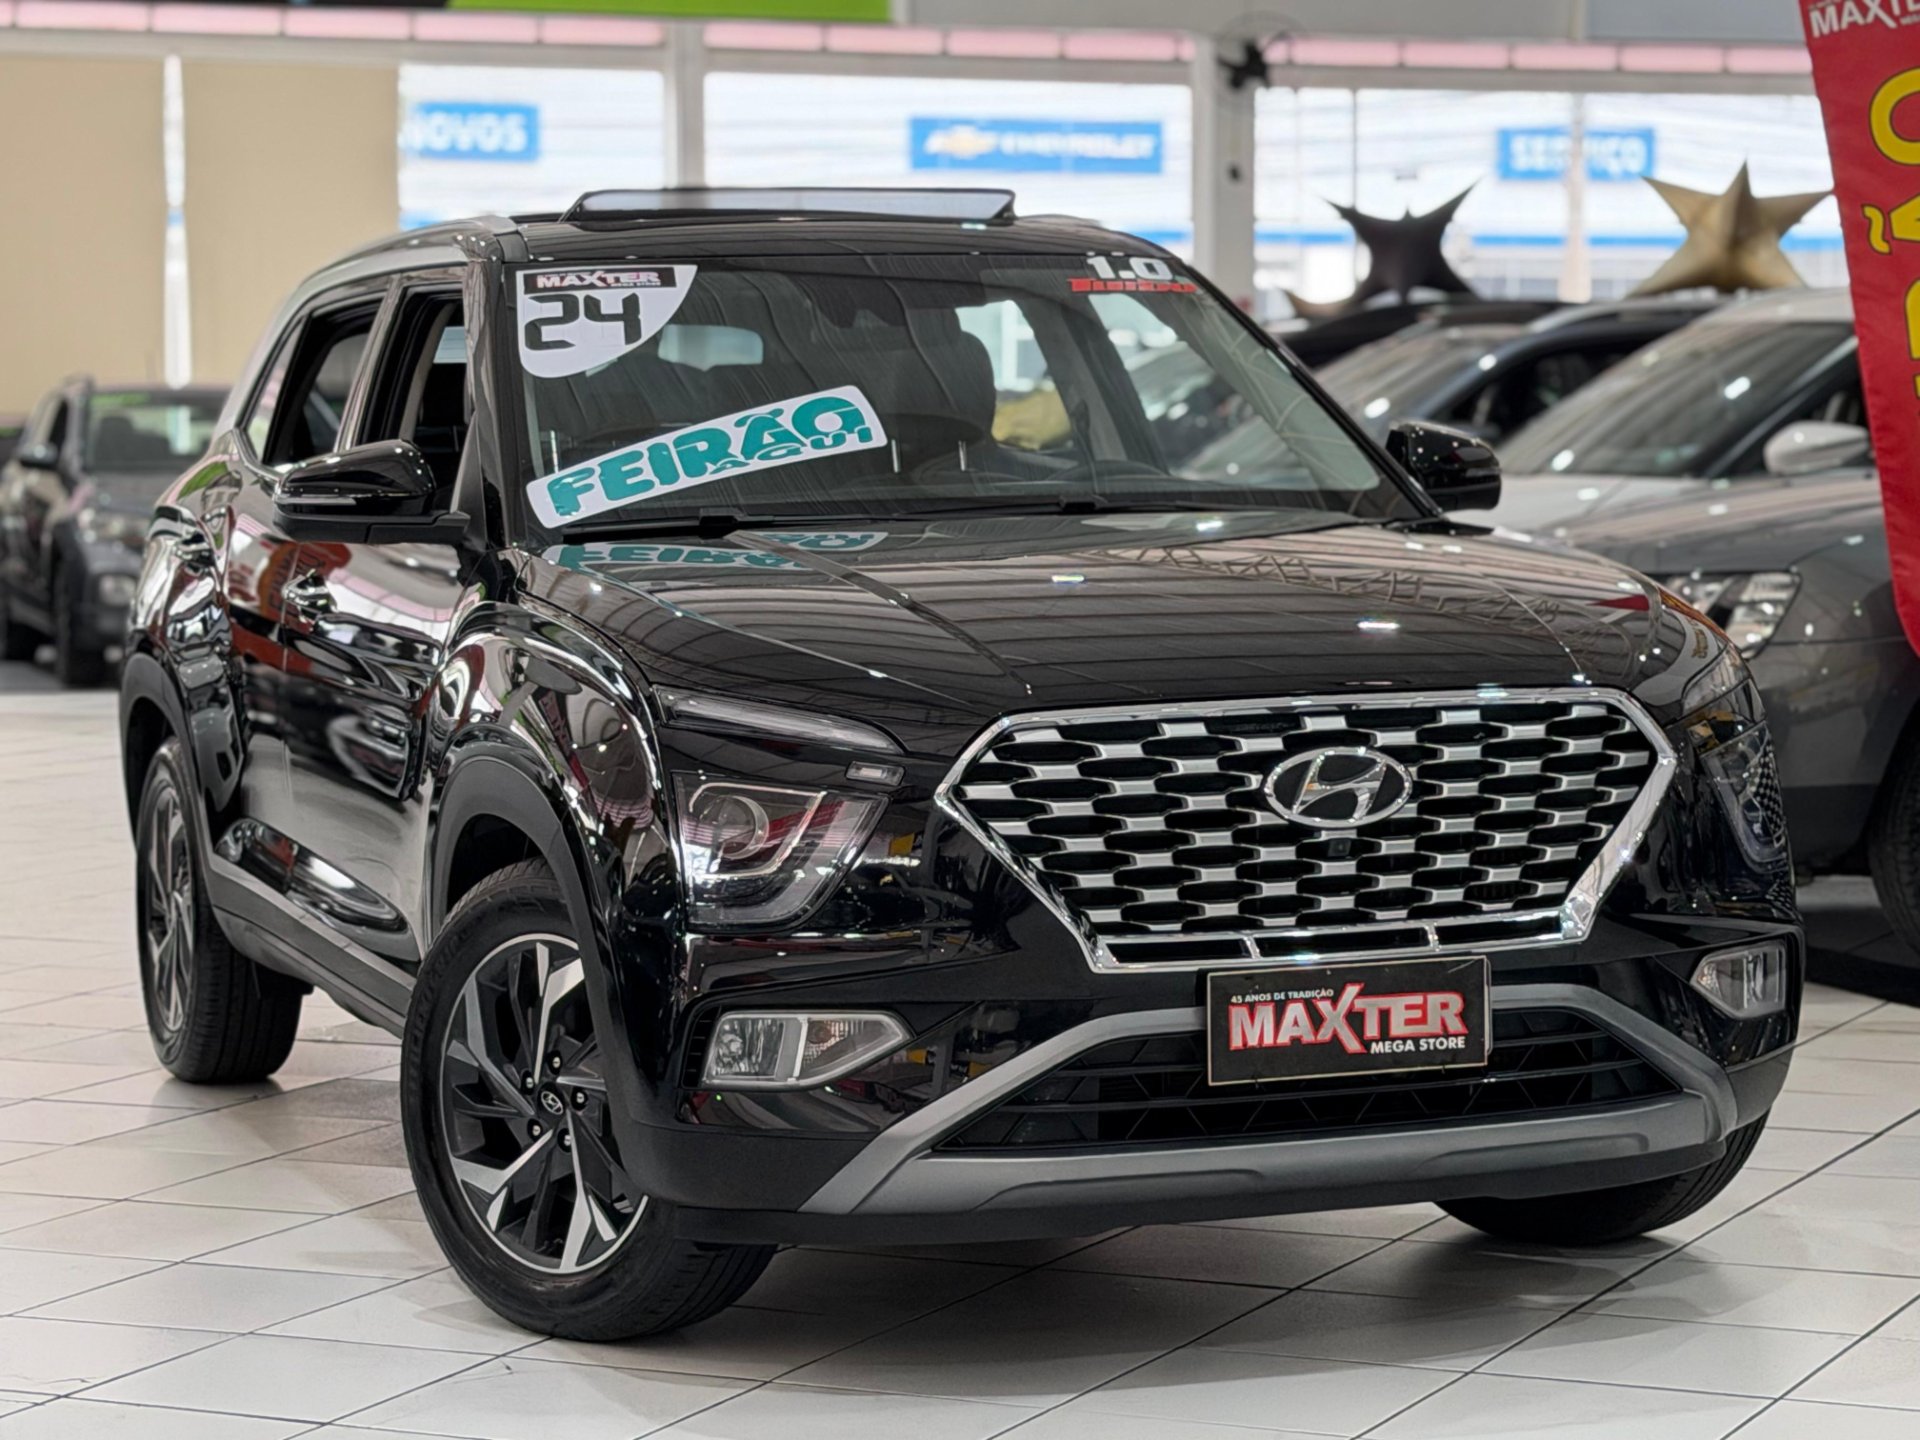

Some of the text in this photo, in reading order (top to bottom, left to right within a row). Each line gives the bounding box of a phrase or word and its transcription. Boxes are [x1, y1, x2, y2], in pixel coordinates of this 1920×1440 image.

[536, 270, 661, 288] MAXTER
[1086, 256, 1173, 280] 1.0
[524, 292, 642, 351] 24
[547, 396, 866, 517] FEIRÃO
[1231, 987, 1334, 1003] 45 ANOS DE TRADIÇÃO
[1228, 983, 1468, 1053] MAXTER
[1370, 1037, 1466, 1054] MEGA STORE
